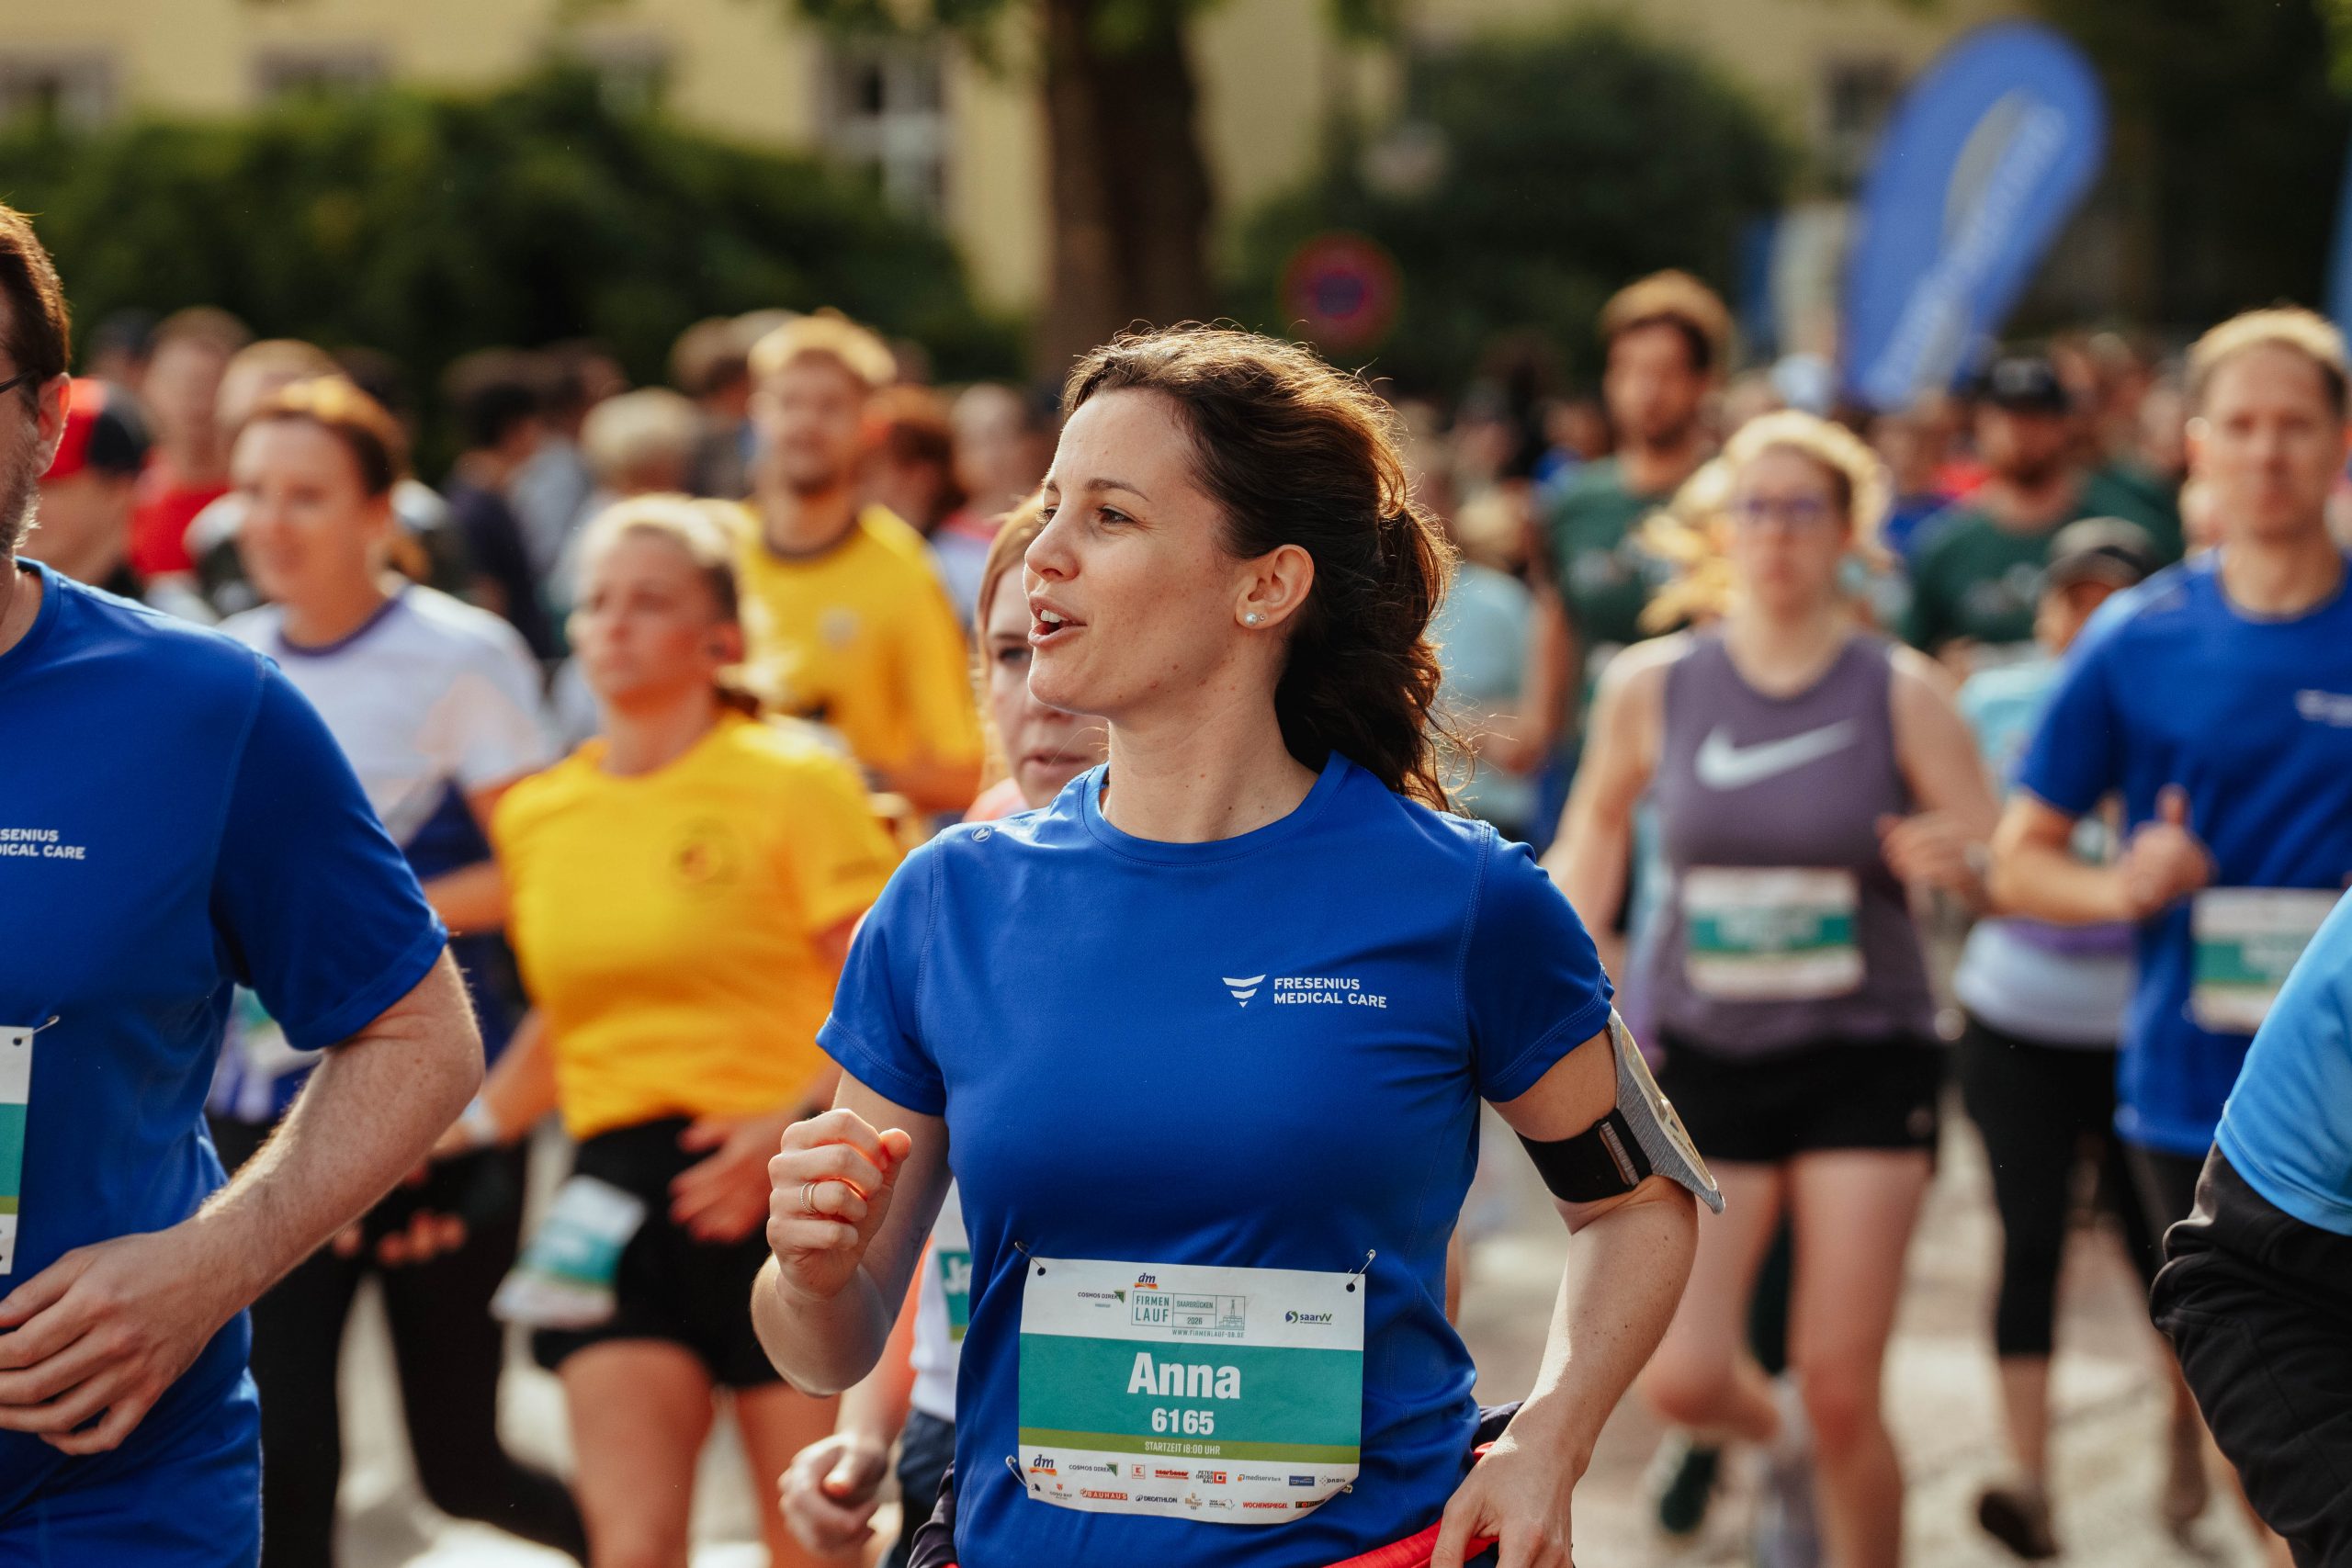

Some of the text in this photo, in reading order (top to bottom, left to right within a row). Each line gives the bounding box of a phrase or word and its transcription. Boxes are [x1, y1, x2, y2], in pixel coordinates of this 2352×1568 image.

[0, 843, 86, 860] ICAL CARE
[1274, 977, 1361, 990] FRESENIUS
[1273, 992, 1387, 1009] MEDICAL CARE
[1138, 1272, 1156, 1284] dm
[1136, 1295, 1170, 1307] FIRMEN
[1136, 1307, 1170, 1323] LAUF
[1126, 1351, 1241, 1400] Anna
[1151, 1407, 1215, 1435] 6165
[1145, 1440, 1221, 1455] STARTZEIT 18:00 UHR
[1034, 1454, 1055, 1468] dm
[1088, 1490, 1127, 1500] BAUHAUS
[1144, 1495, 1177, 1504] DECATHLON
[1243, 1501, 1288, 1509] WOCHENSPIEGEL
